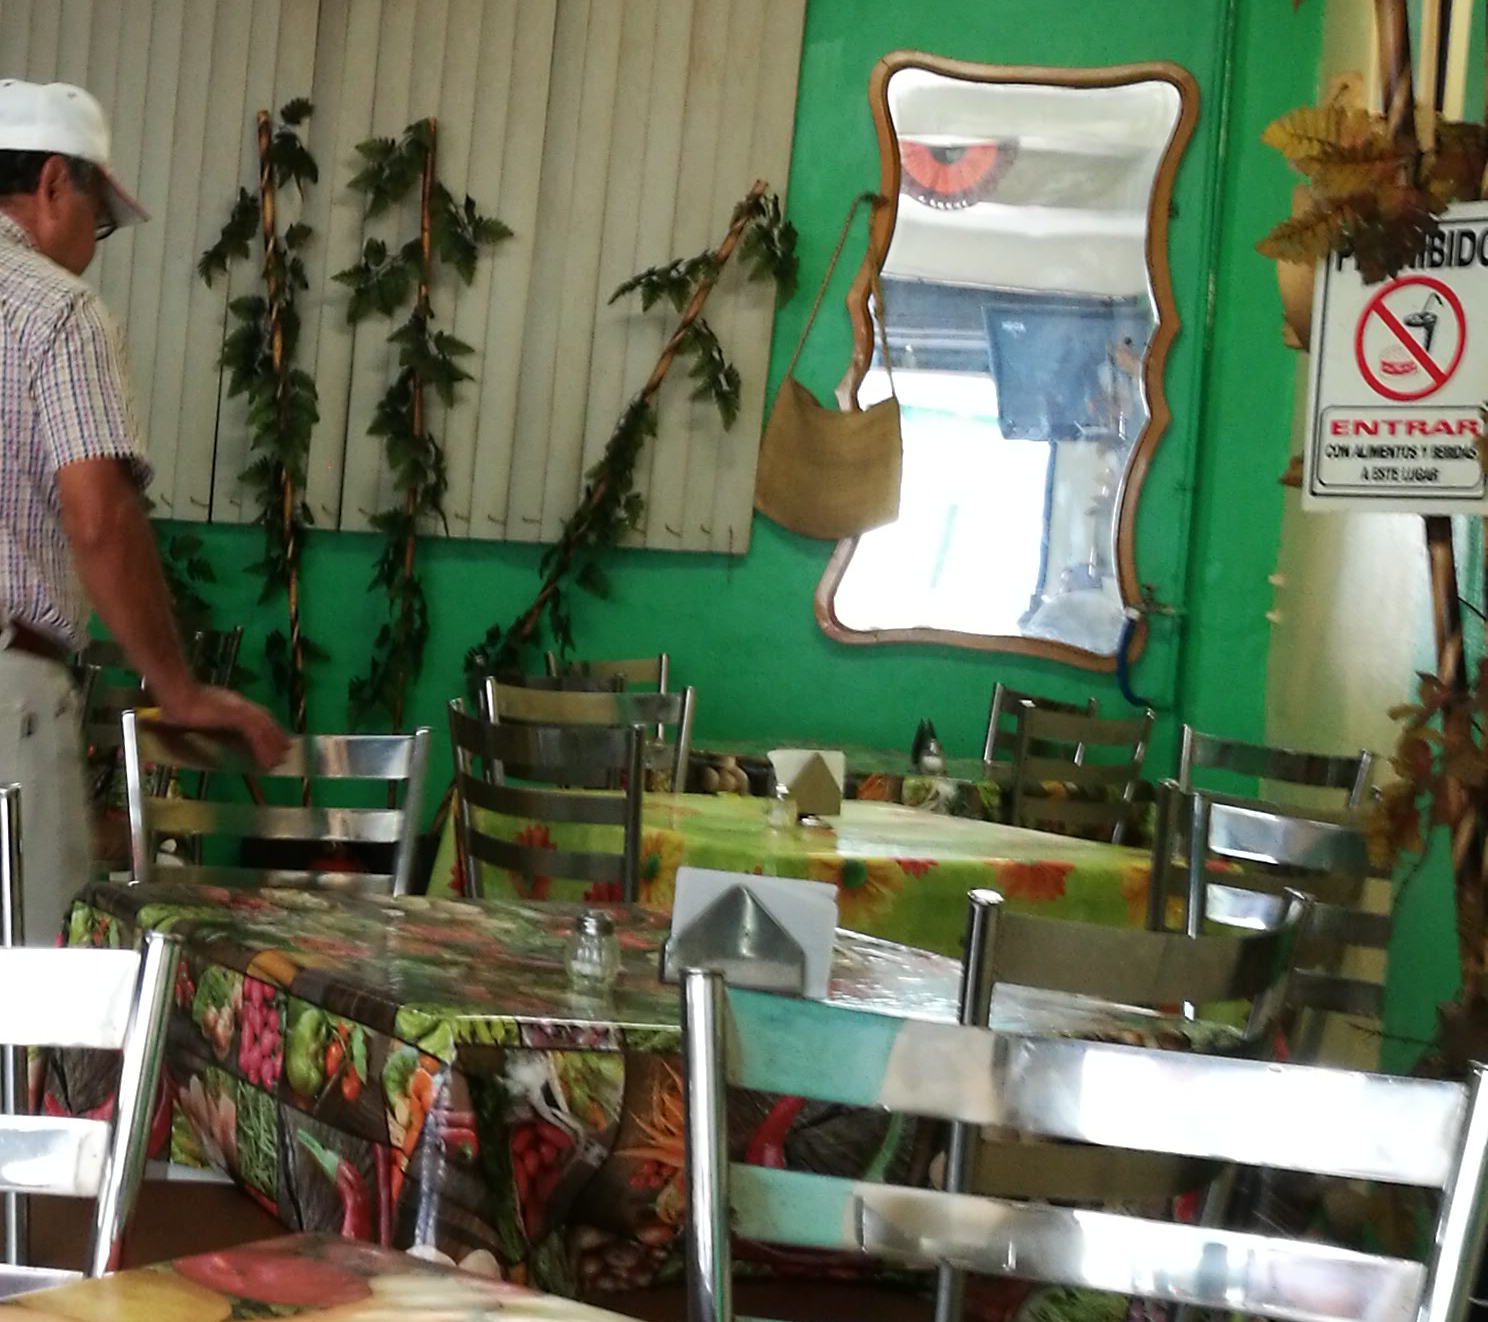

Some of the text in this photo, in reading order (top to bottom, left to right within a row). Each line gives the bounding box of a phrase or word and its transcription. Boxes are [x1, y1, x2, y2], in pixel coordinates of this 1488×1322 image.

[1330, 419, 1479, 437] ENTRAR
[1325, 444, 1350, 458] CON
[1353, 444, 1417, 459] ALIMENTOS
[1361, 466, 1440, 481] A ESTE LUGAR
